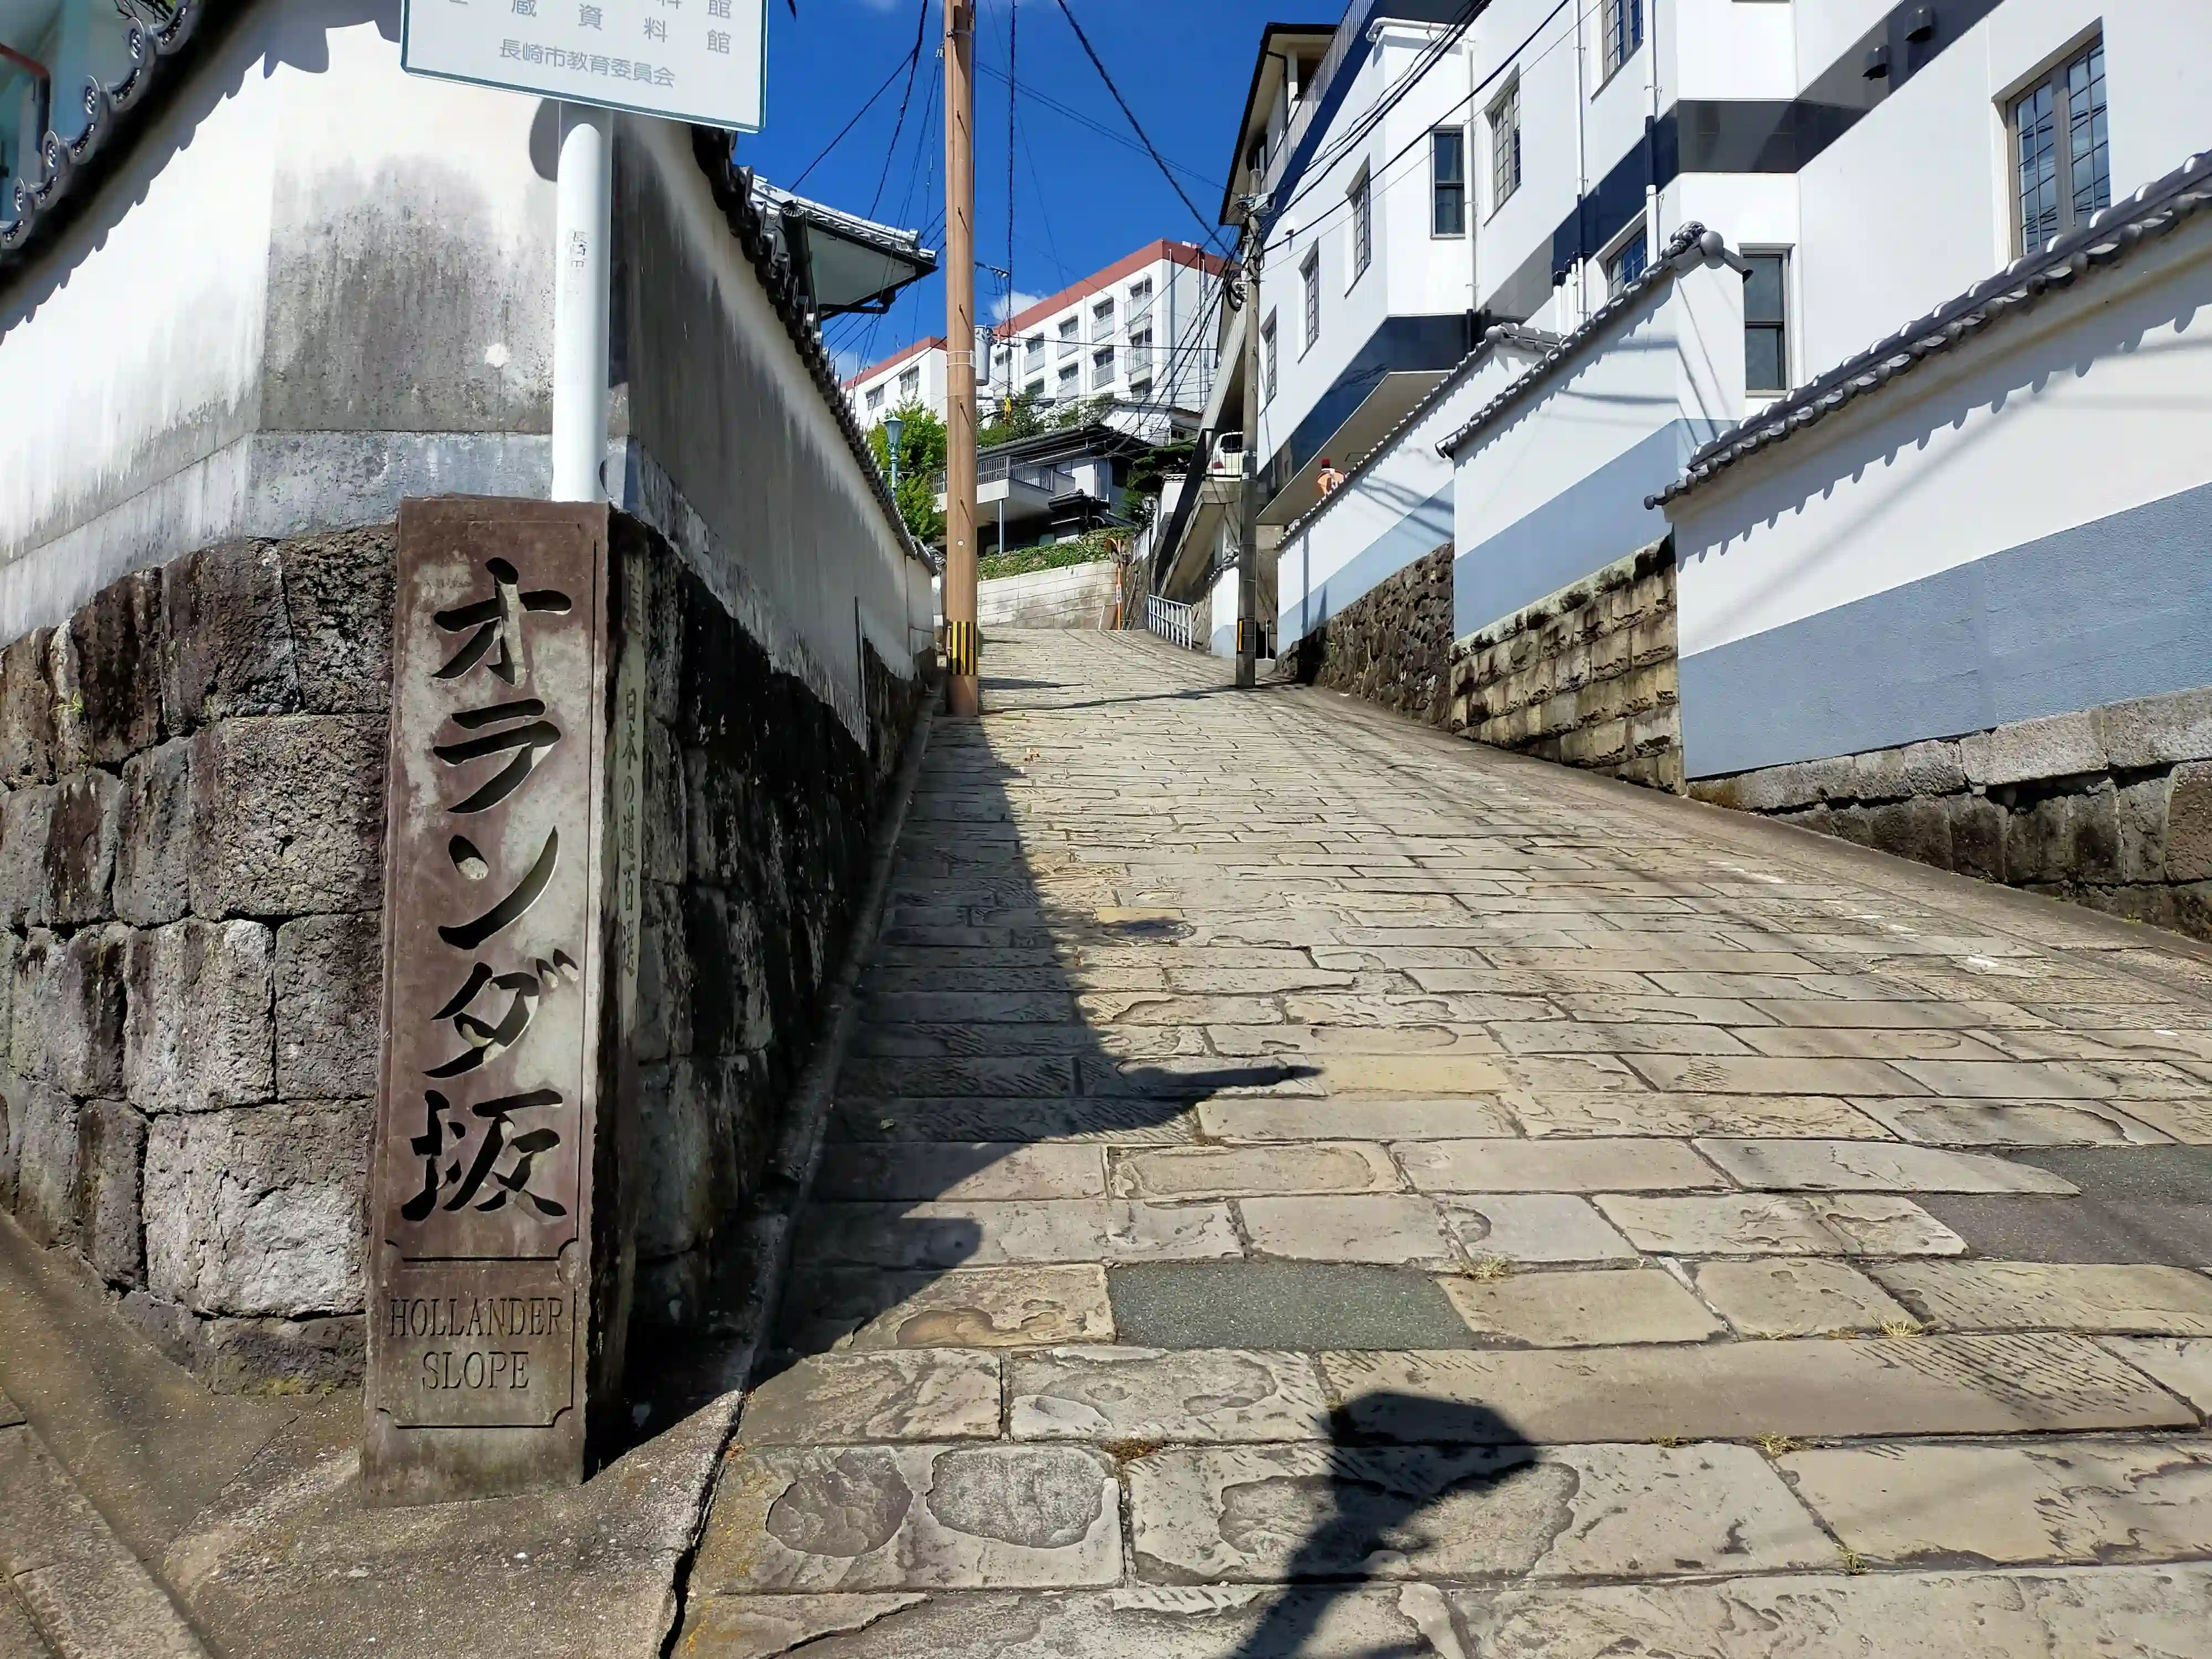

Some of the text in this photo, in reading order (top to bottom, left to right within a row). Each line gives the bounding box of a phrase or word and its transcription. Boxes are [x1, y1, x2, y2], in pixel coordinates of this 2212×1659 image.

[449, 0, 731, 54] 蔵資料館
[499, 38, 675, 88] 長崎市教育委員会
[622, 687, 638, 978] 日本の道百選
[401, 556, 579, 1222] オランダ坂
[389, 1297, 565, 1337] HOLLANDER
[422, 1351, 530, 1391] SLOPE
